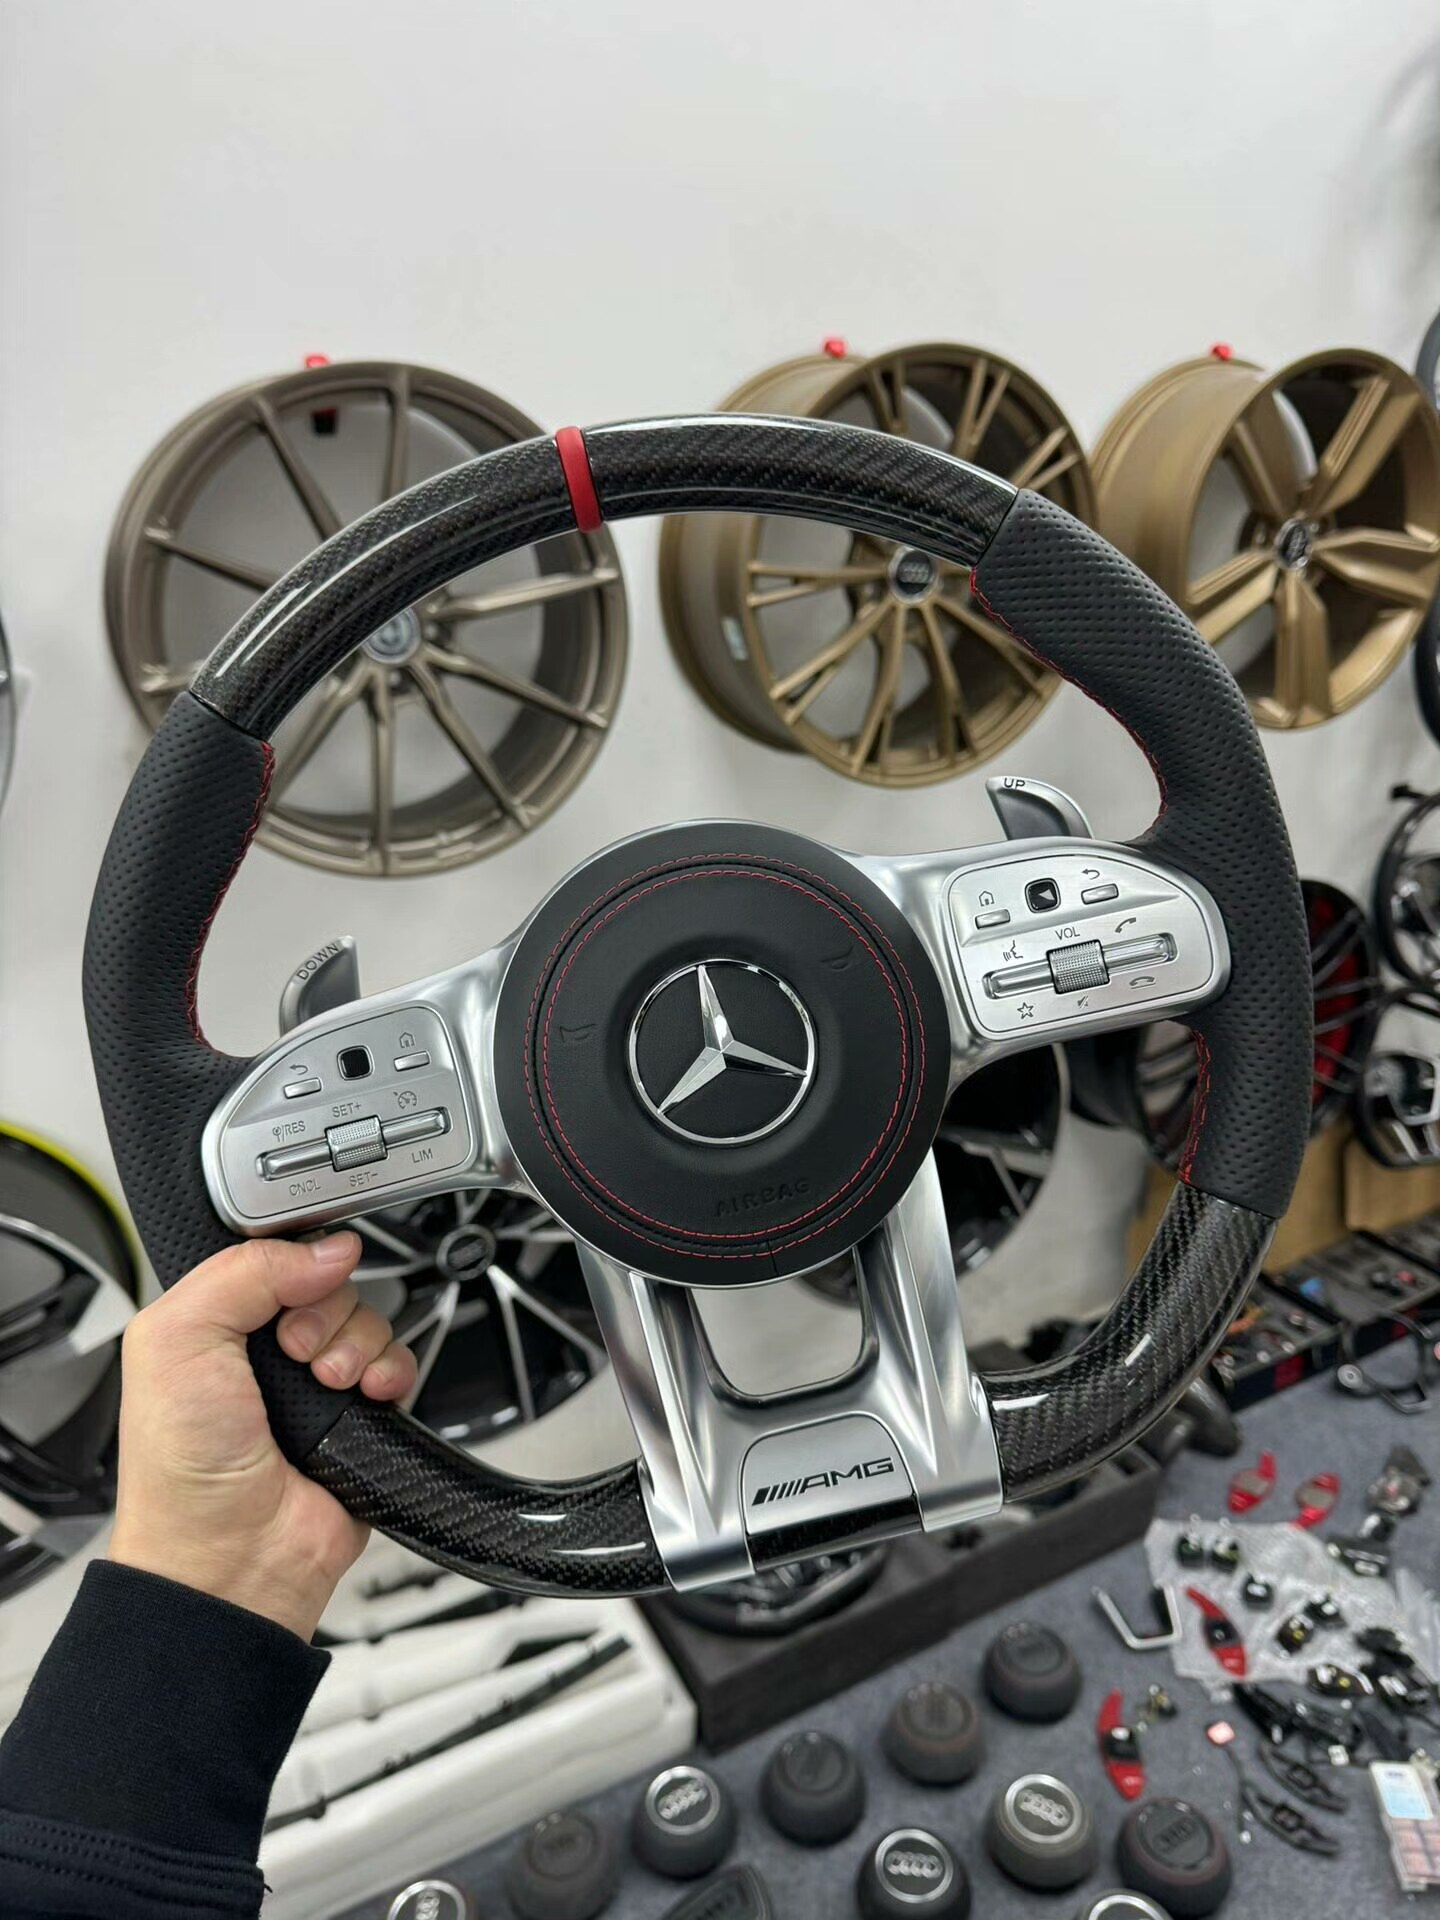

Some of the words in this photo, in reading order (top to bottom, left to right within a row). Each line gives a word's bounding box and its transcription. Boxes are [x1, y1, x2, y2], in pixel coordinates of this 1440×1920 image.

[1003, 777, 1026, 789] UP
[1055, 926, 1081, 940] VOL
[296, 943, 340, 981] DOWN
[332, 1102, 362, 1118] SET+
[411, 1149, 433, 1164] LIM
[289, 1179, 321, 1196] CNCL
[716, 1179, 811, 1217] AIRBAG
[799, 1456, 895, 1493] AMG
